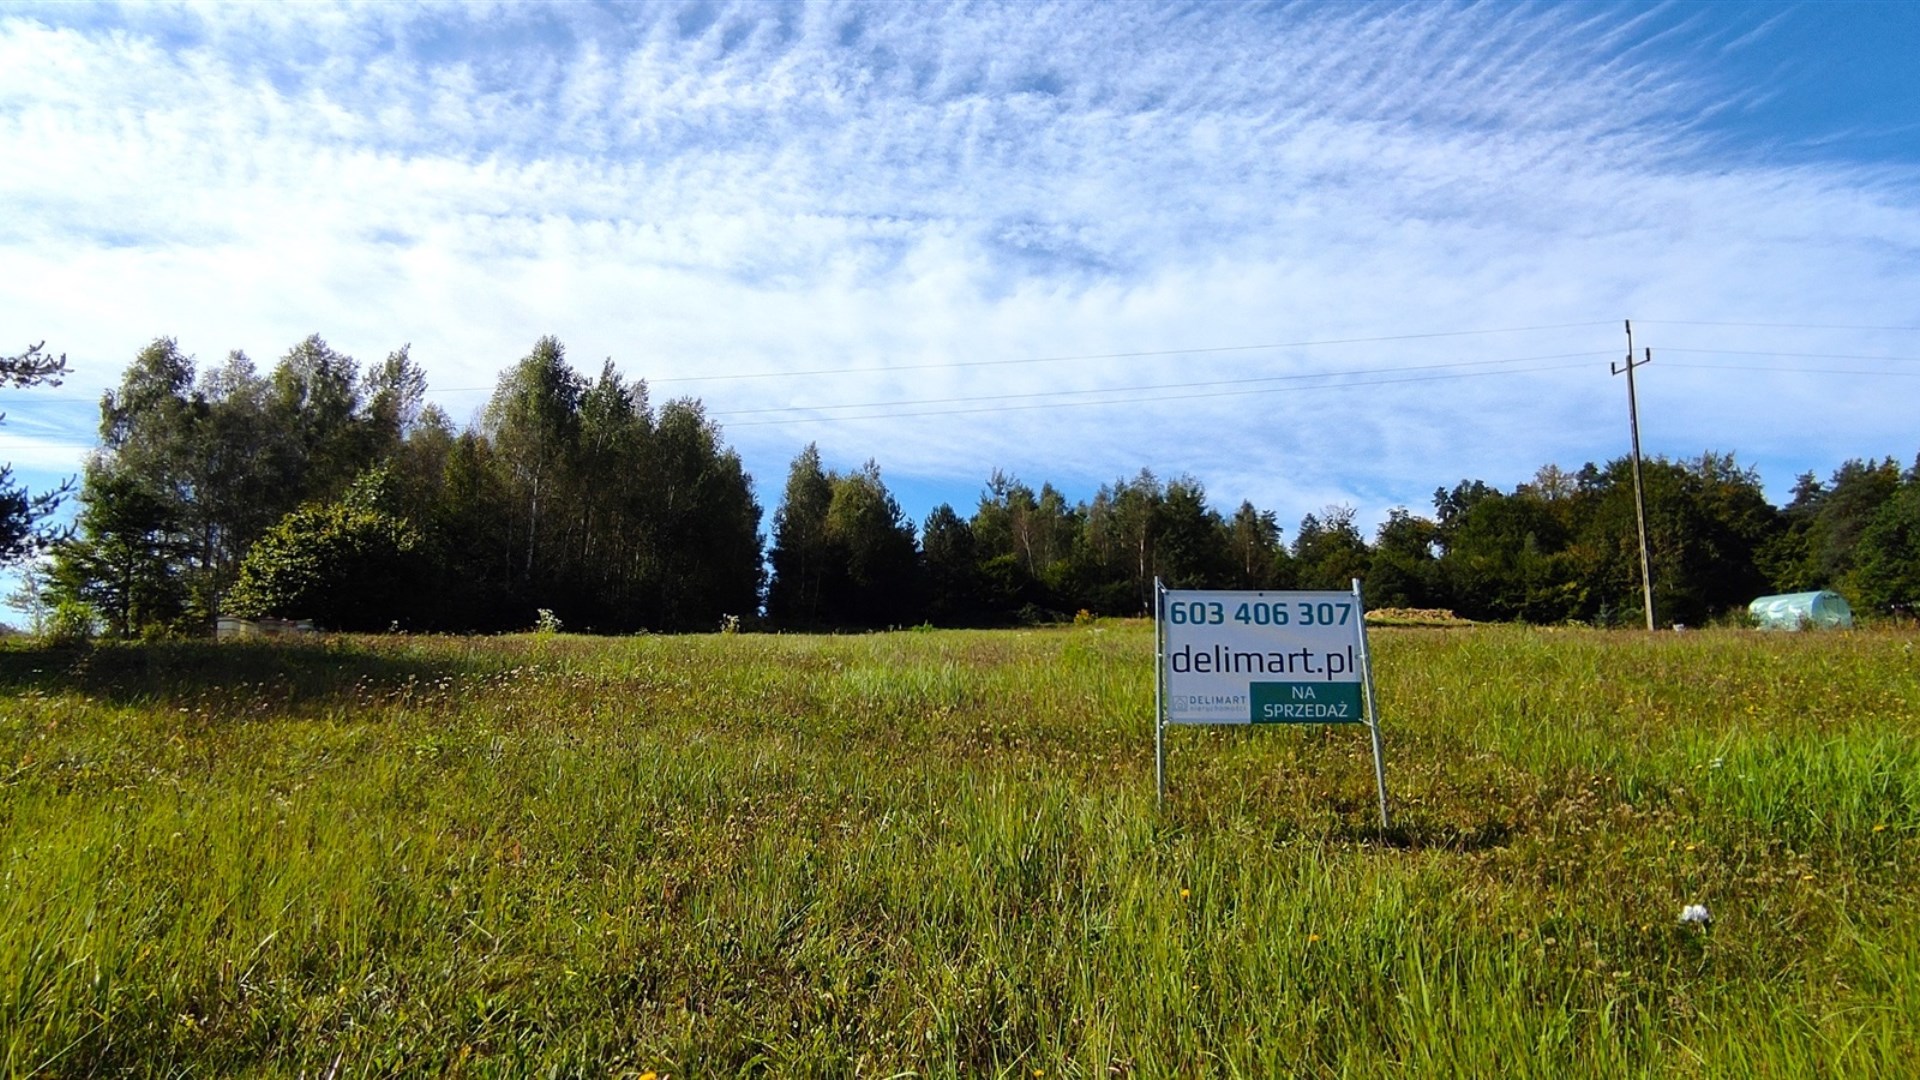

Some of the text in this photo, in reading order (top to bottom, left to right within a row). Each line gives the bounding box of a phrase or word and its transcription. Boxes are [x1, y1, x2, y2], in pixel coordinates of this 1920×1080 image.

[1170, 602, 1351, 625] 603 406 307
[1171, 644, 1353, 681] delimart.pl
[1190, 695, 1247, 704] DELIMART
[1292, 686, 1316, 699] NA
[1264, 701, 1348, 718] SPRZEDAŻ
